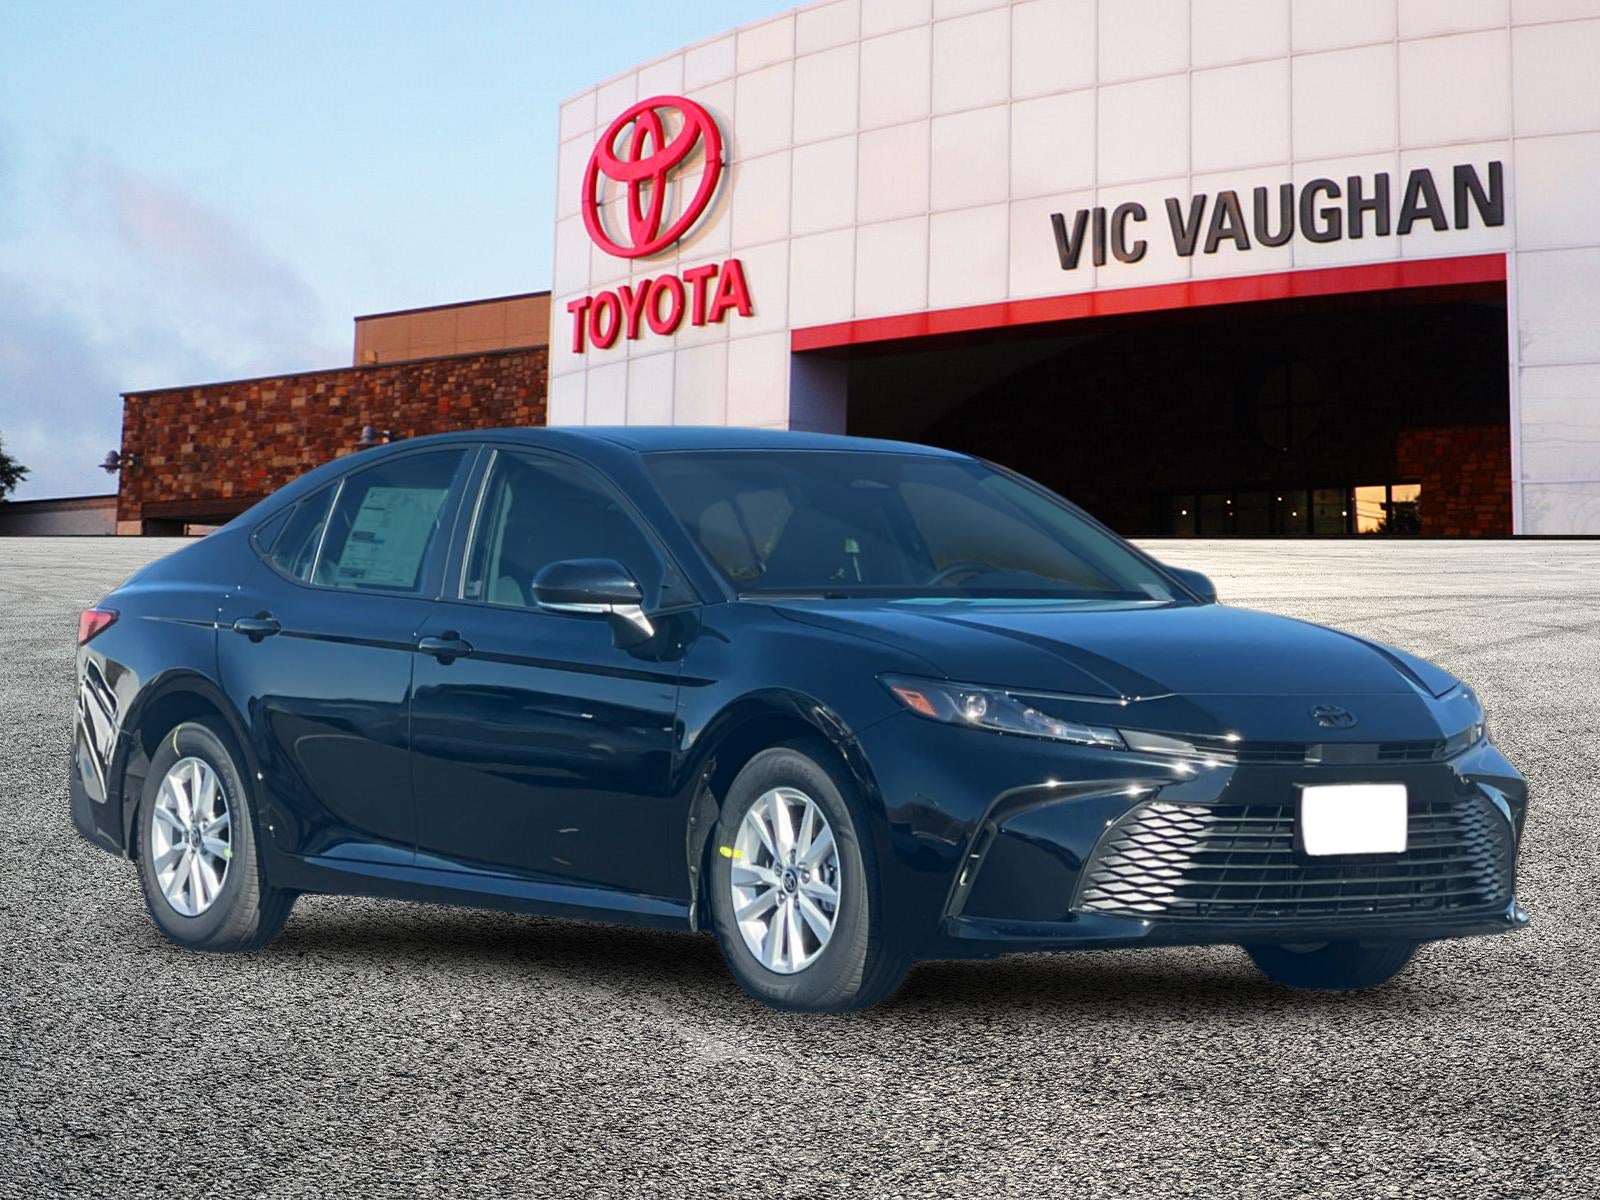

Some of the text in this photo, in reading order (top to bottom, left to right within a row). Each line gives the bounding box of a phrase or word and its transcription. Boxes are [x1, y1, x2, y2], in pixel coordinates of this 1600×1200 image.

[1050, 161, 1505, 270] VIC VAUGHAN
[567, 258, 754, 354] TOYOTA
